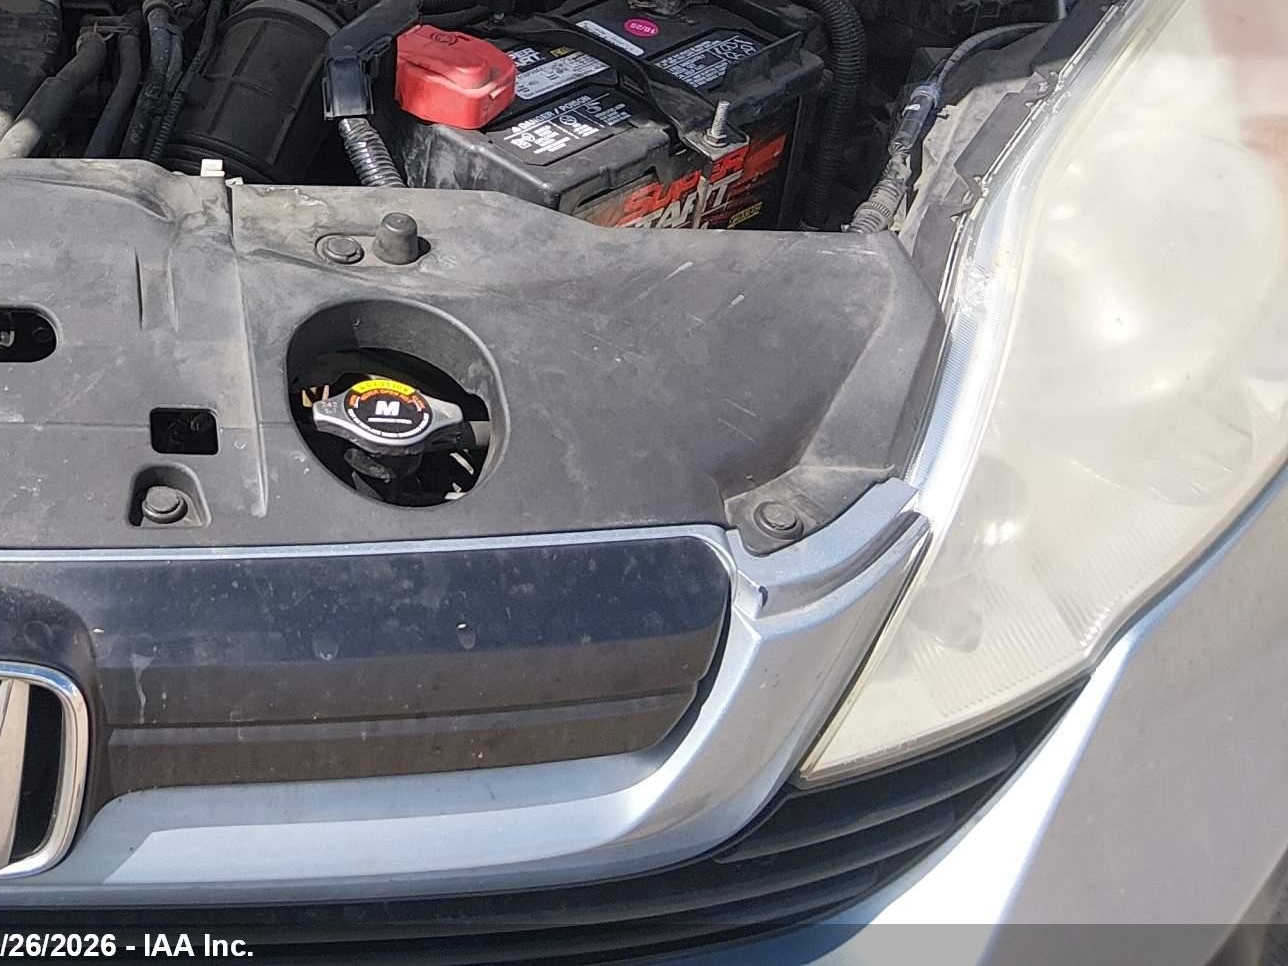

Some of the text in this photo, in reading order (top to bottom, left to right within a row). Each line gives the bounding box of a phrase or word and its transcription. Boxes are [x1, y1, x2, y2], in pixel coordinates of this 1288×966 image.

[518, 111, 555, 130] DANGER
[558, 95, 592, 112] POISON
[375, 400, 400, 416] M
